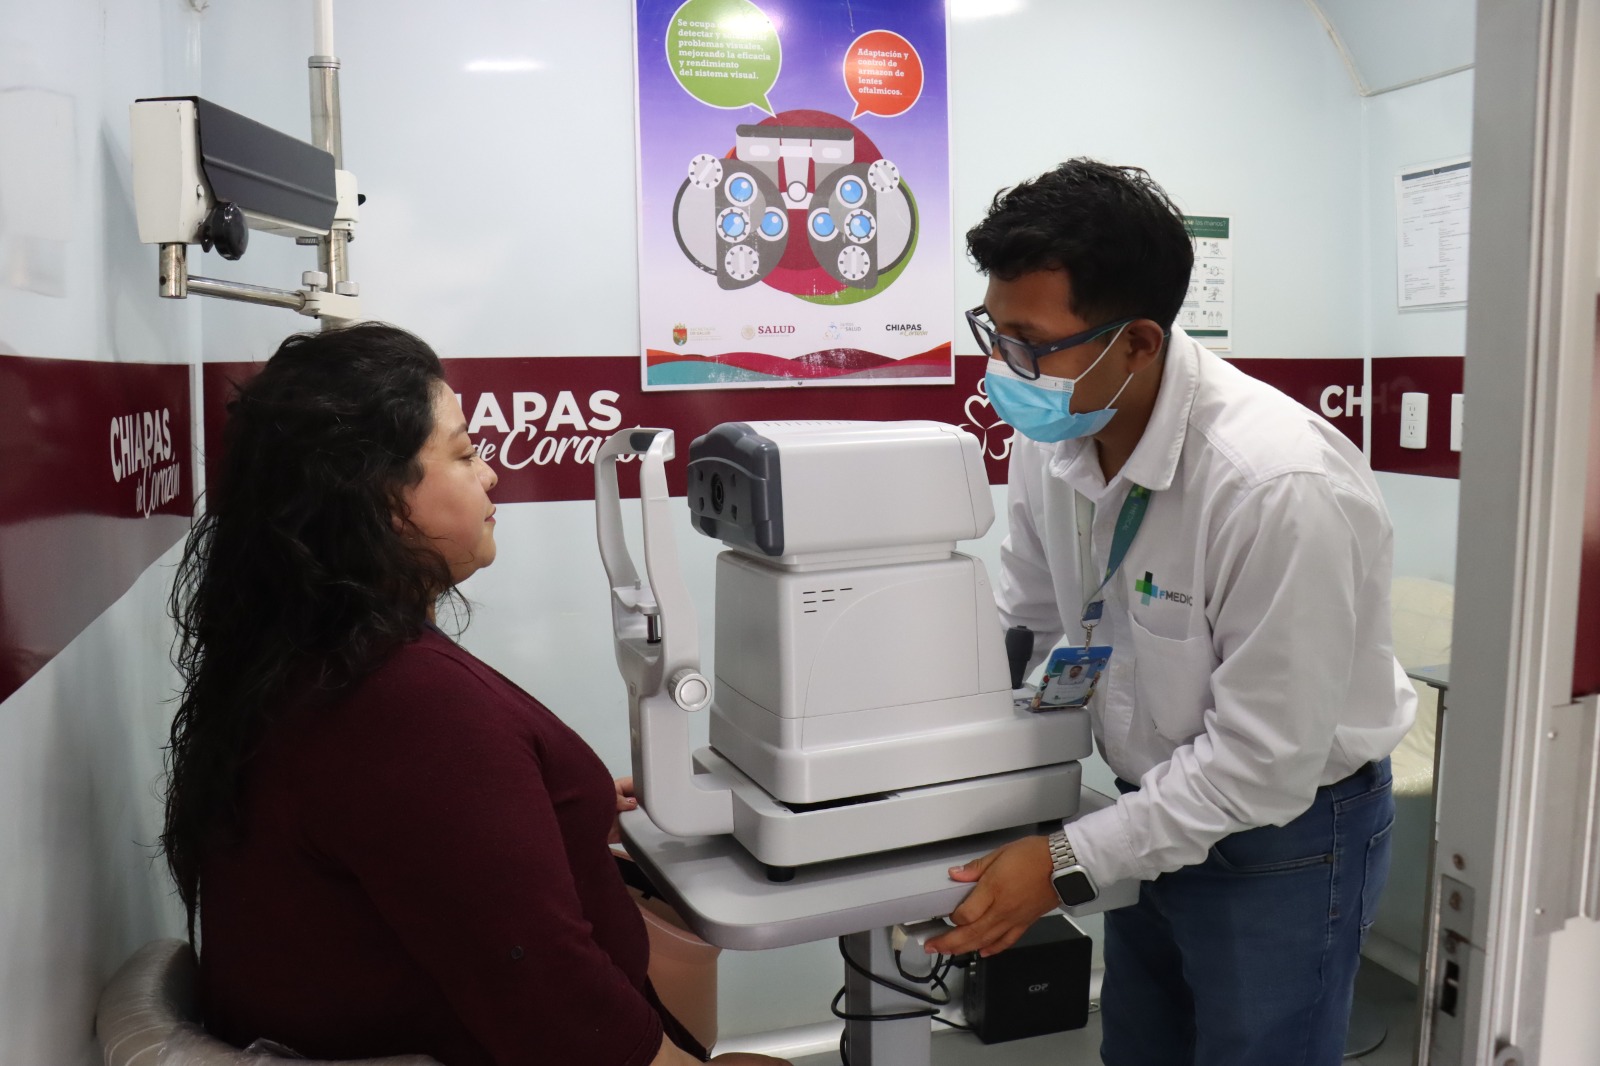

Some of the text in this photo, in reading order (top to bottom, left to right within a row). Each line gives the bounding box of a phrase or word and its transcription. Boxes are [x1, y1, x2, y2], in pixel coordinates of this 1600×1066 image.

[678, 19, 688, 27] Se
[689, 21, 716, 30] ocupa
[678, 29, 714, 38] detectar
[716, 32, 721, 40] y
[678, 39, 764, 51] problemas visuales,
[679, 49, 771, 60] mejorando la eficacia
[857, 48, 909, 60] Adaptación y
[686, 60, 740, 69] rendimiento
[858, 59, 886, 67] control
[679, 68, 759, 79] del sistema visual.
[858, 69, 905, 77] armazon de
[858, 77, 883, 85] lentes
[858, 87, 903, 96] oftalmicos.
[758, 325, 796, 334] SALUD
[885, 324, 922, 332] CHIAPAS
[455, 390, 622, 435] APAS
[110, 407, 172, 483] CHIAPAS
[499, 423, 646, 470] Cora
[136, 451, 180, 520] de Corazón
